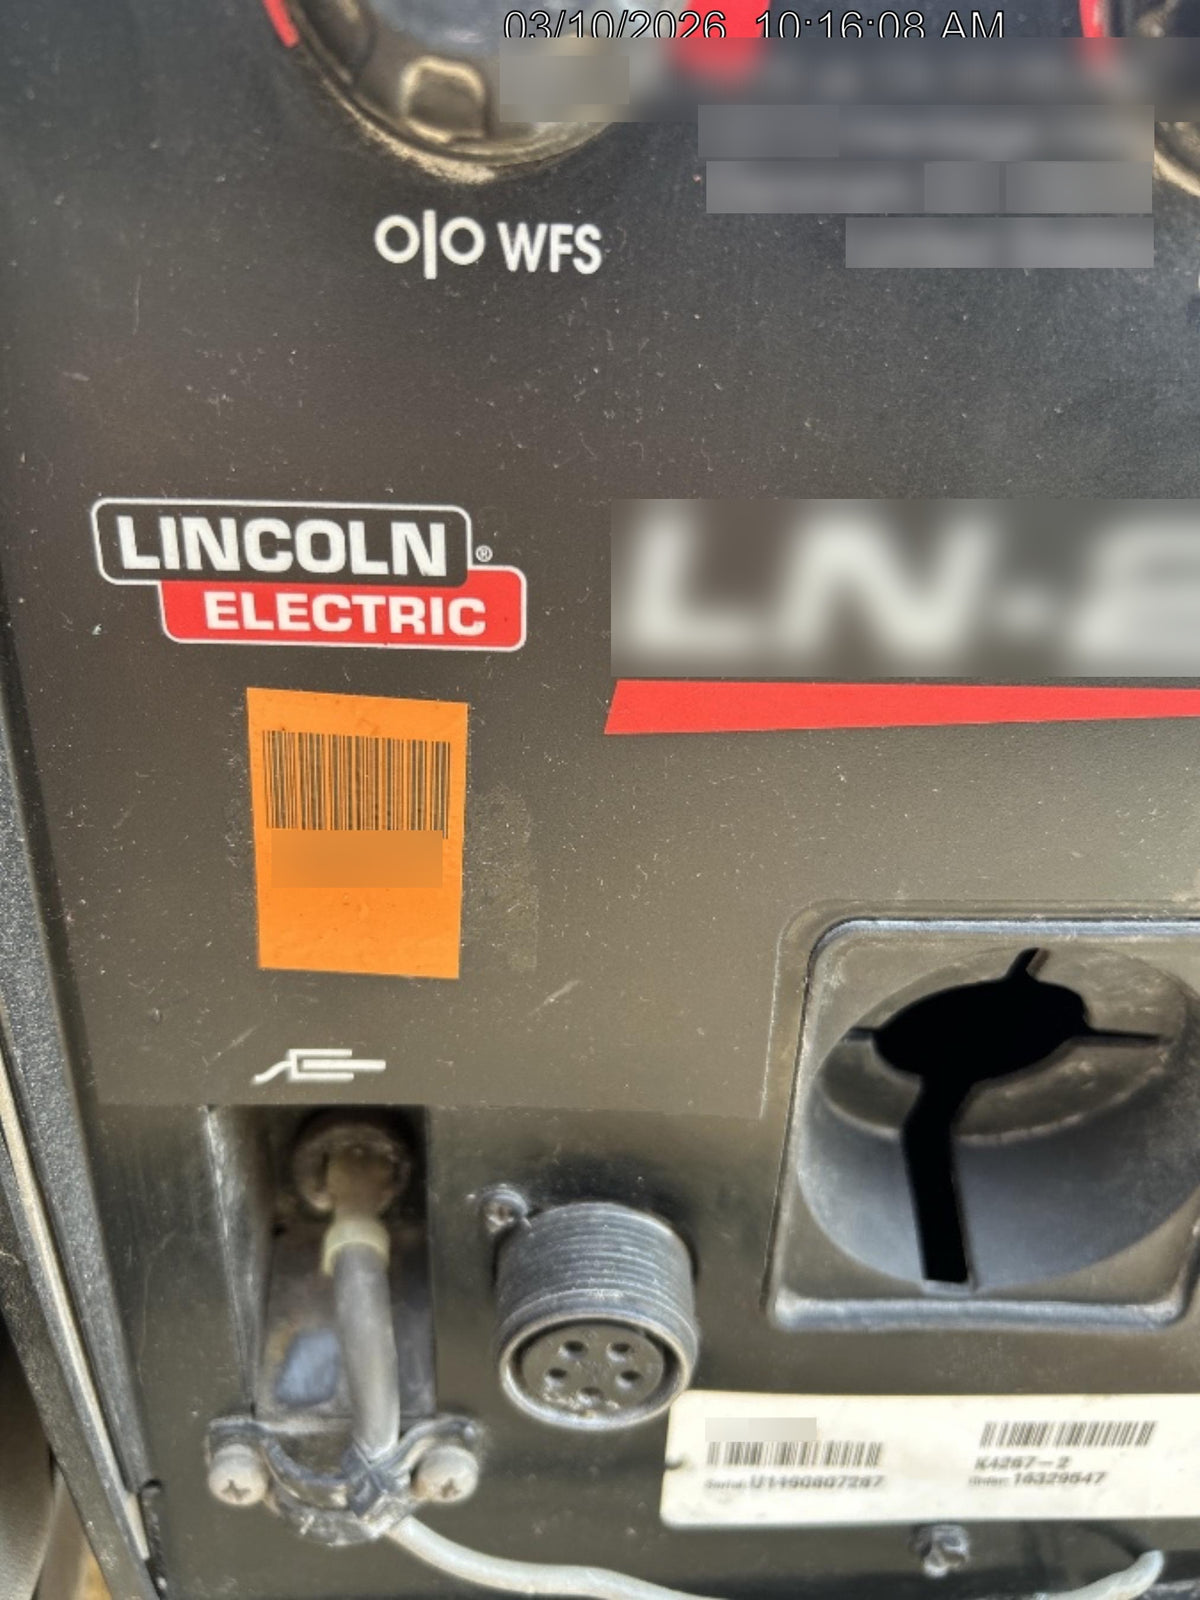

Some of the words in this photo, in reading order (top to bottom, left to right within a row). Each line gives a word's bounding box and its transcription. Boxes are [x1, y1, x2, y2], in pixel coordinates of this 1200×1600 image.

[498, 221, 602, 274] WFS
[117, 516, 446, 576] LINCOLN
[204, 592, 486, 635] ELECTRIC
